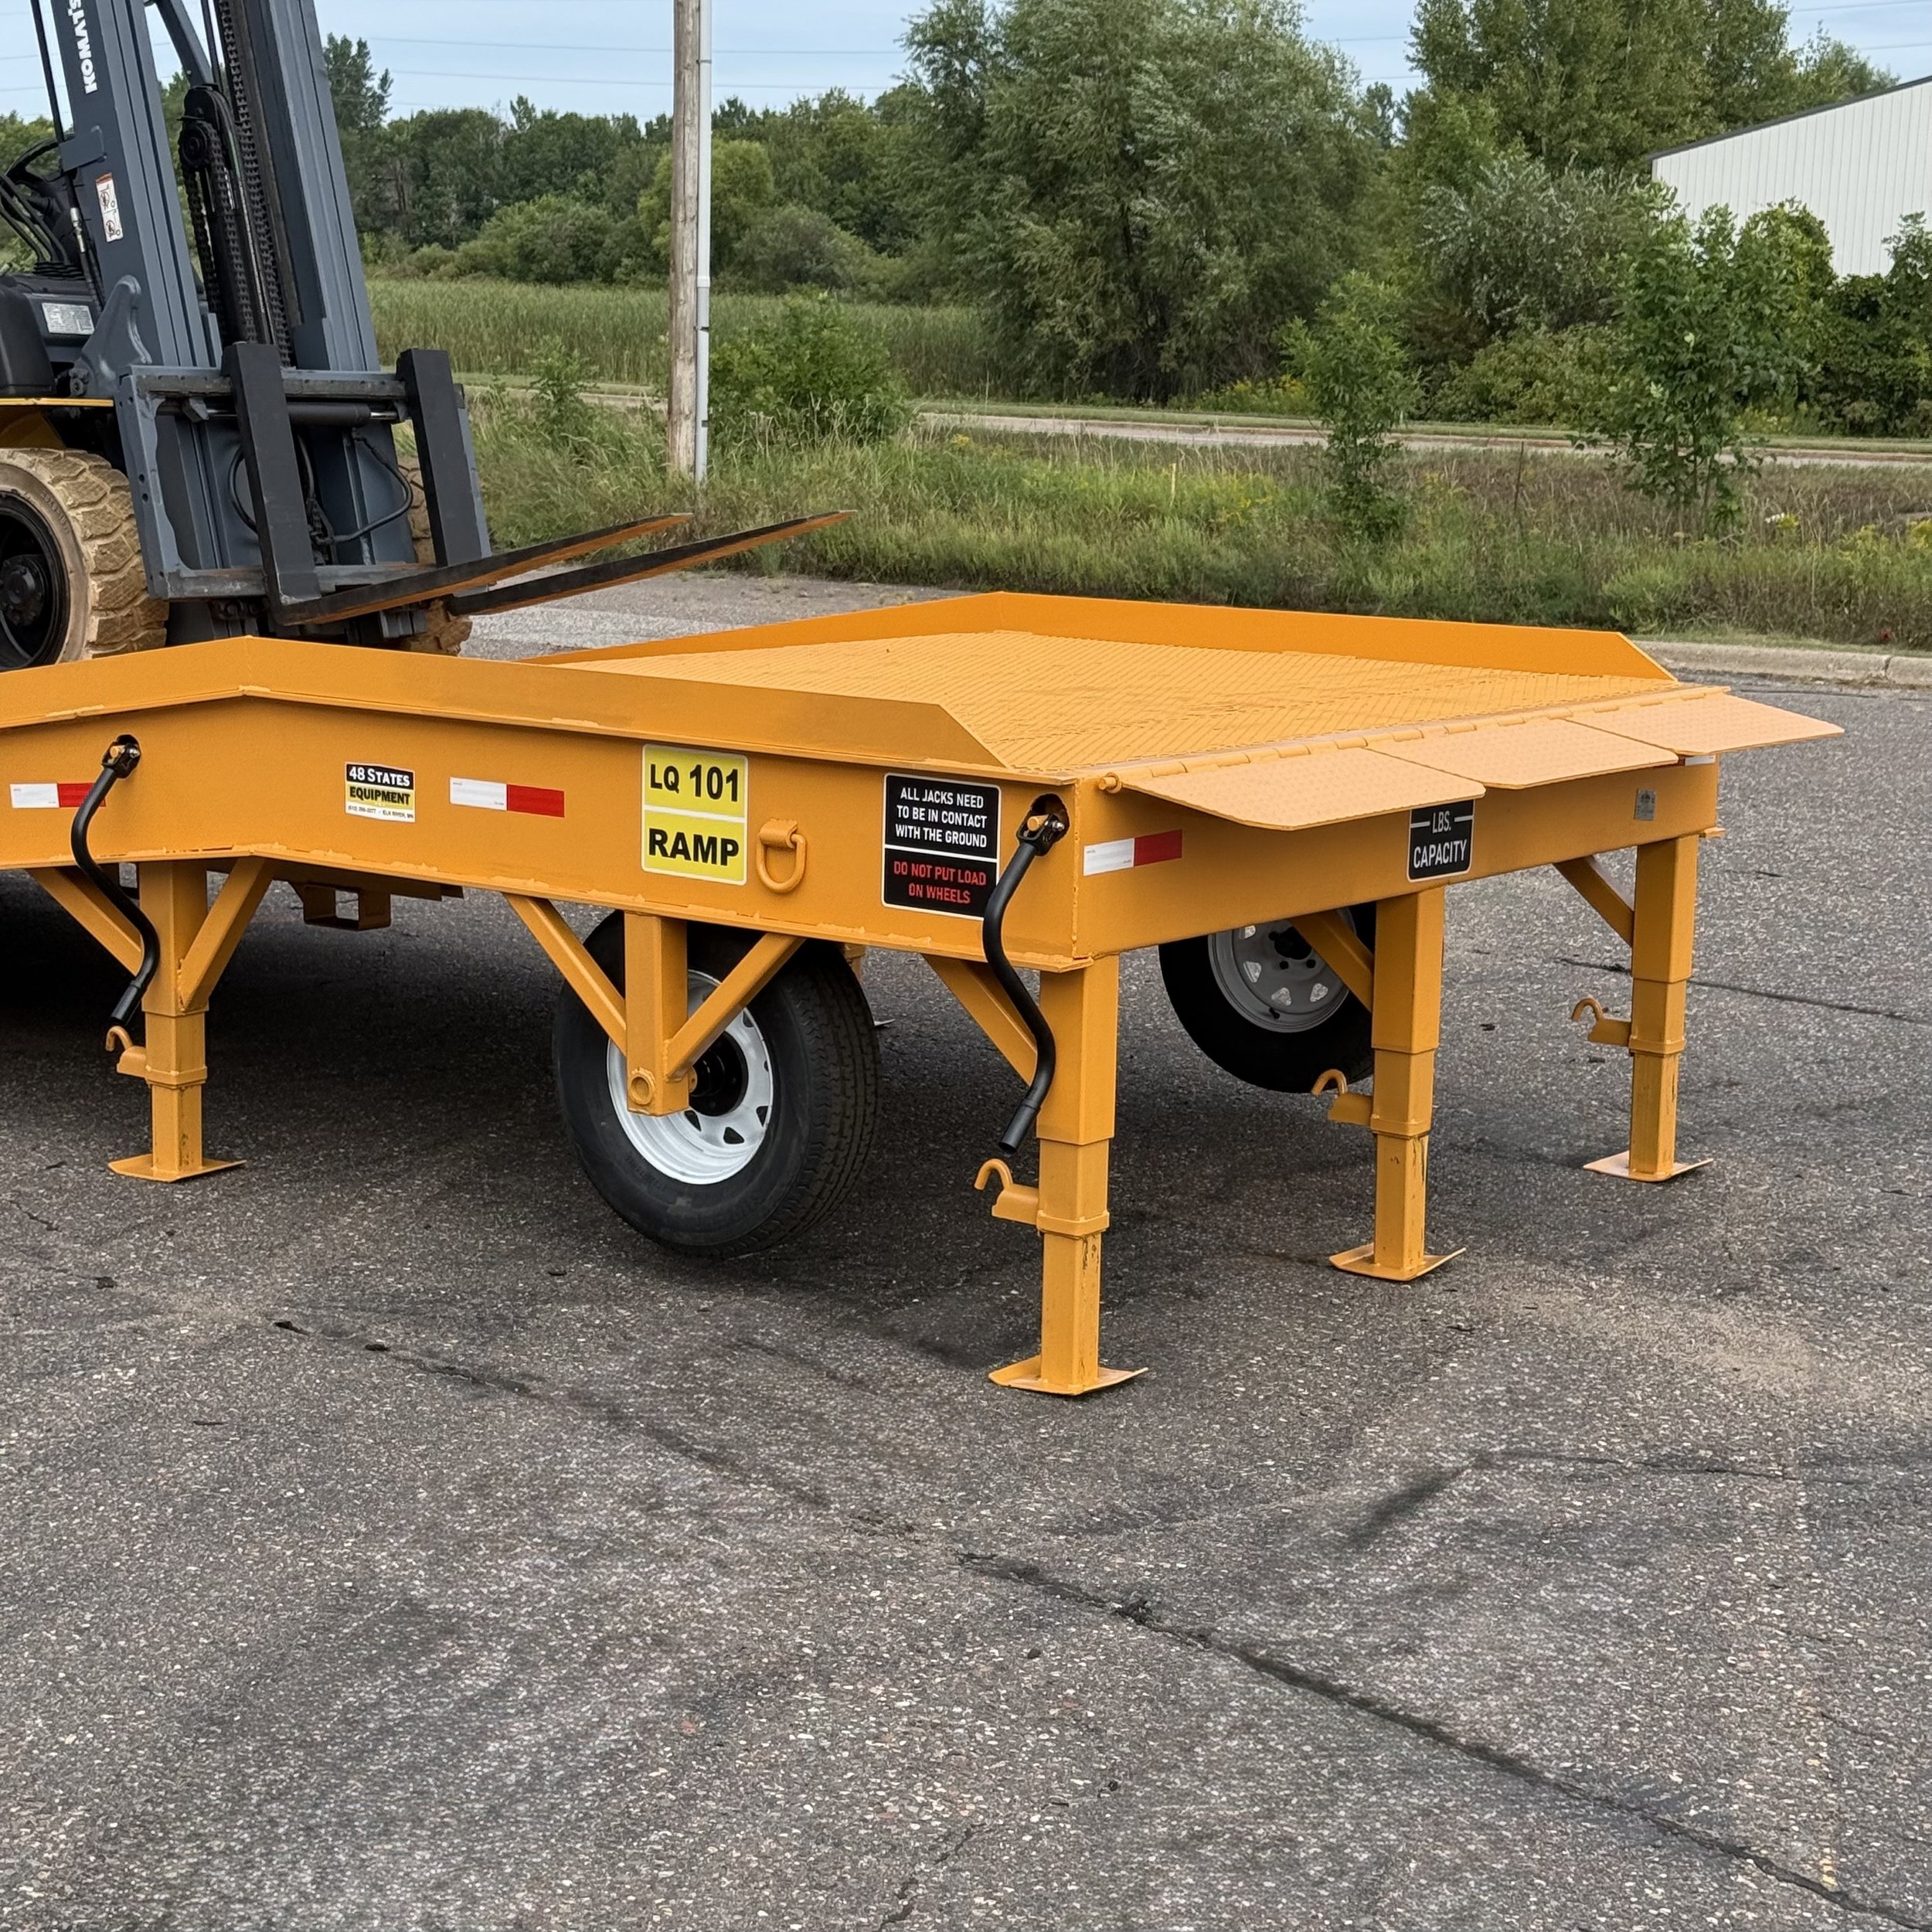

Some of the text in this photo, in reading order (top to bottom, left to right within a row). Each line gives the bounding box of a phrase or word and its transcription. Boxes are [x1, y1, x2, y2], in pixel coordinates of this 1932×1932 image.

[349, 766, 410, 787] 48 STATES
[650, 764, 738, 802] LQ 101
[349, 786, 410, 806] EQUIPMENT
[900, 787, 984, 809] ALL JACKS NEED
[896, 805, 988, 828] TO BE IN CONTACT
[1432, 810, 1451, 834] LBS.
[648, 828, 740, 866] RAMP
[895, 824, 987, 848] WITH THE GROUND
[1413, 838, 1468, 869] CAPACITY
[893, 861, 987, 886] DO NOT PUT LOAD
[908, 883, 971, 904] ON WHEELS
